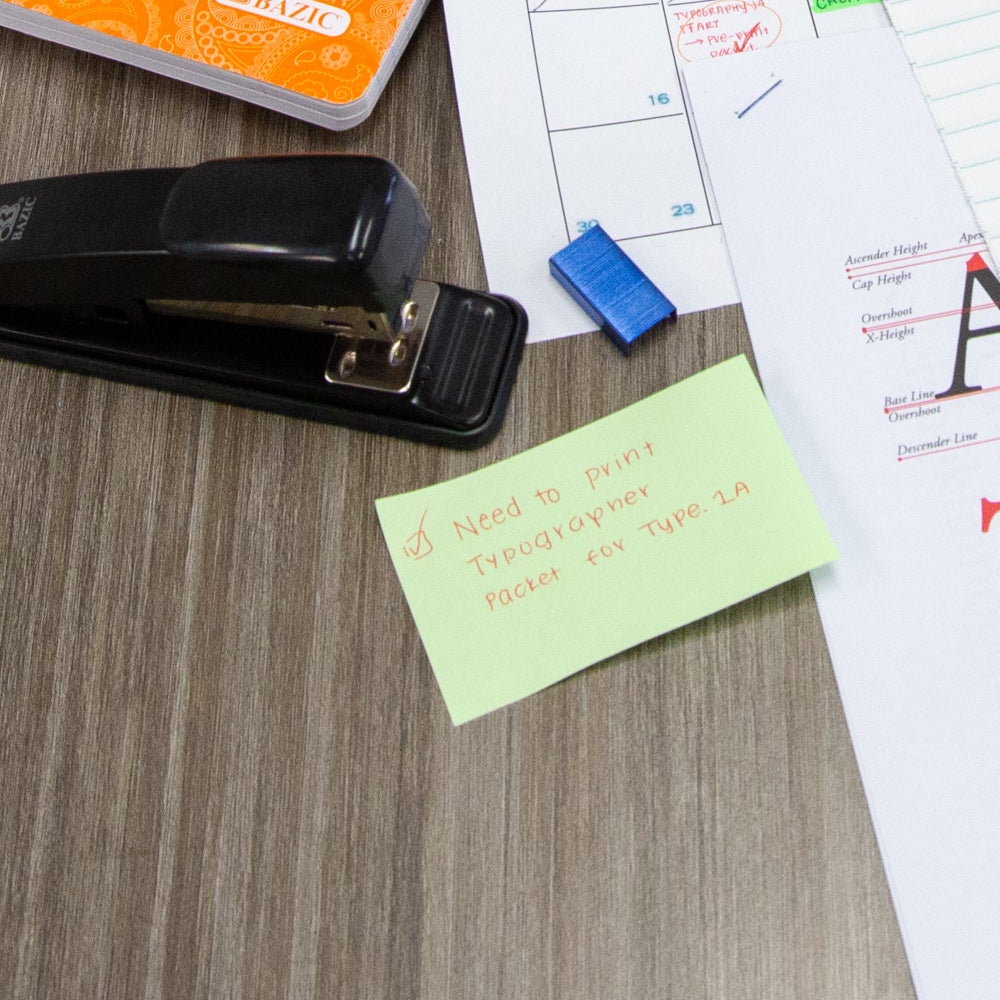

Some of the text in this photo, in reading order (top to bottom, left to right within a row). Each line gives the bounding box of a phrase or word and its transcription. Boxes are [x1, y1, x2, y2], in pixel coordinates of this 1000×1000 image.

[649, 93, 669, 105] 16
[11, 197, 36, 241] BAZIC
[672, 204, 695, 216] 23
[845, 242, 928, 266] Ascender Height
[852, 271, 912, 291] Cap Height
[861, 307, 912, 324] Overshoot
[866, 326, 914, 344] X-Height
[884, 390, 935, 407] Base Line
[889, 405, 941, 423] Overshoot
[898, 432, 978, 456] Descender Line
[452, 440, 655, 542] Need to print
[467, 483, 650, 576] Typographer
[587, 538, 626, 565] for
